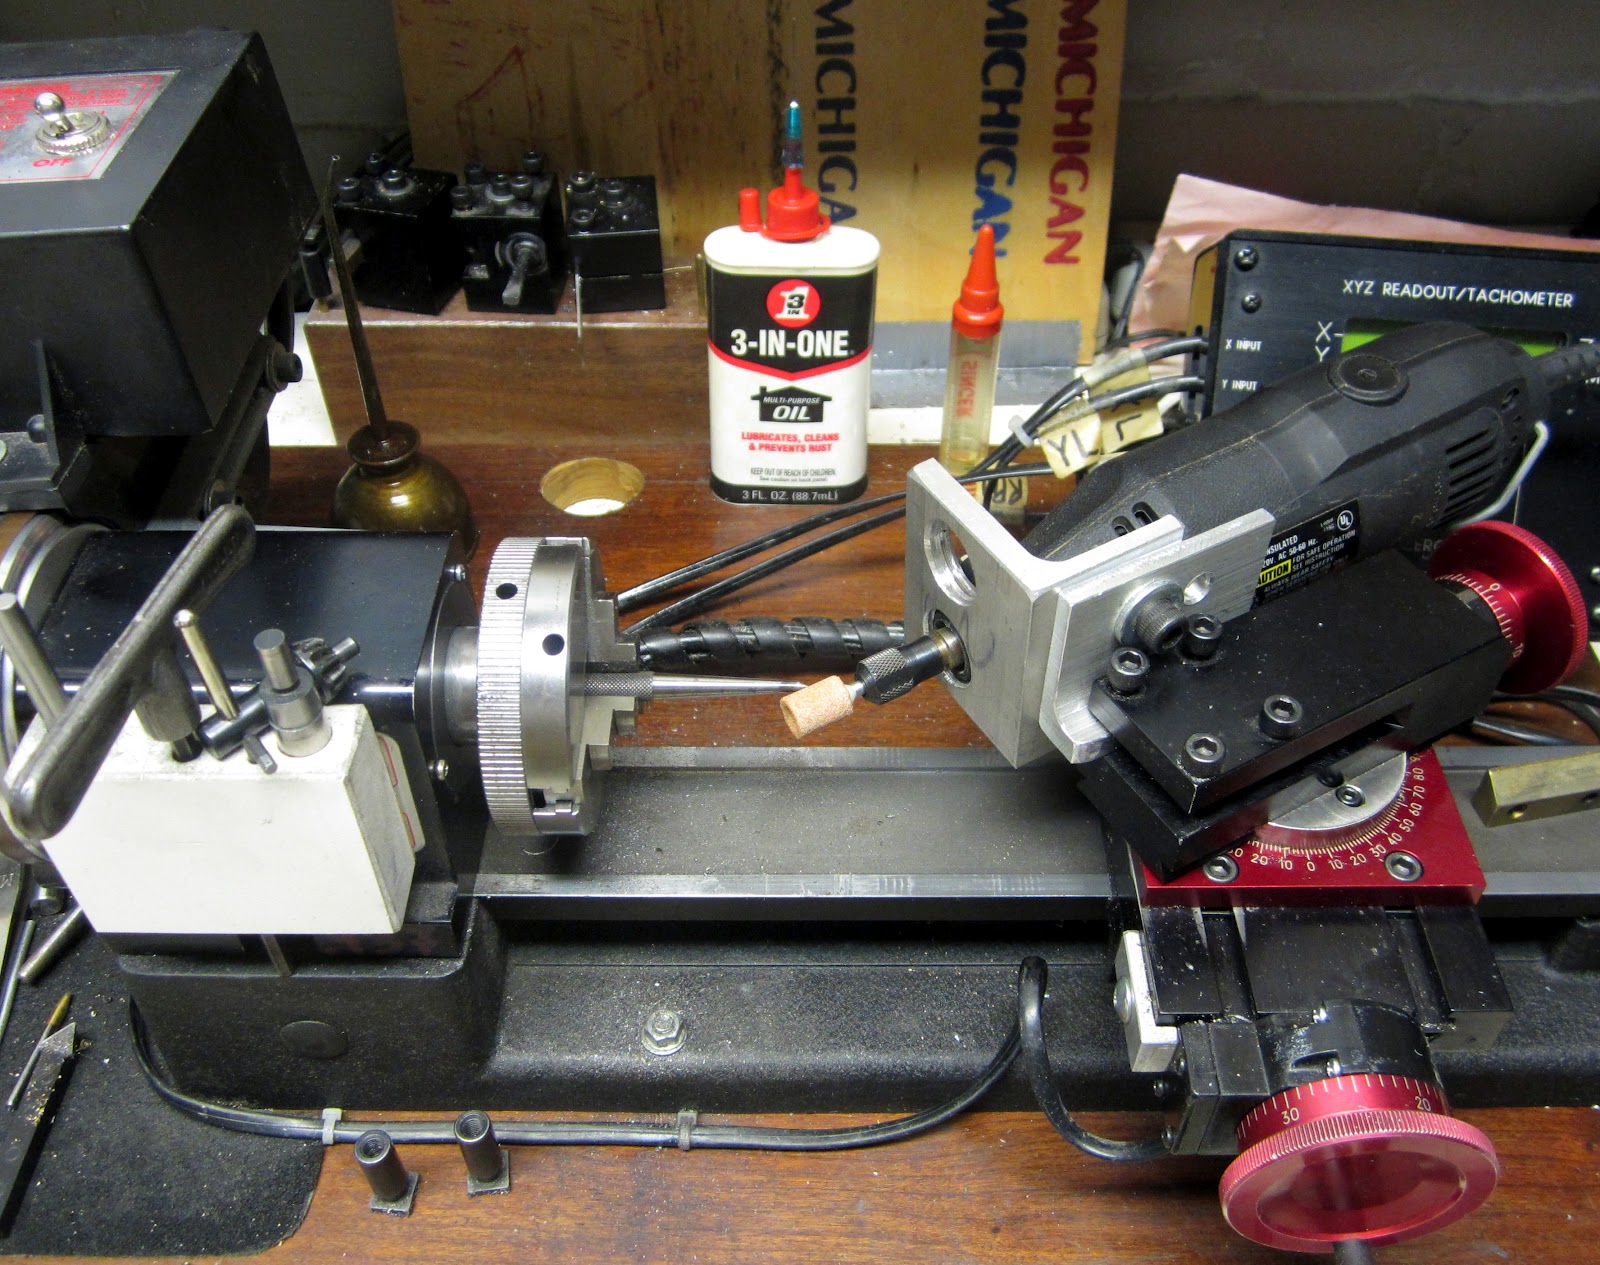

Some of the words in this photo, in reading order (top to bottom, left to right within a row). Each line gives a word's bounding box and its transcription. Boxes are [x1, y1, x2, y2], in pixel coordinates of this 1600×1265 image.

[814, 0, 857, 226] MICHIGA
[1043, 0, 1099, 264] MICHIGAN
[32, 157, 73, 167] OFF
[1342, 279, 1374, 295] XYZ
[1382, 280, 1574, 308] READOUT/TACHOMETER
[1315, 320, 1333, 343] X
[730, 328, 849, 357] 3-IN-ONE
[1225, 338, 1232, 350] X
[1236, 340, 1262, 351] INPUT
[1315, 345, 1331, 363] Y
[1221, 378, 1228, 389] Y
[1231, 379, 1258, 391] INPUT
[762, 396, 820, 404] MULTI-PURPOSE
[772, 405, 811, 421] OIL
[741, 431, 801, 443] LUBRICATES,
[804, 433, 839, 443] CLEANS
[748, 442, 756, 451] &
[758, 443, 806, 453] PREVENTS
[808, 443, 833, 452] RUST
[750, 467, 763, 475] KEEP
[764, 468, 775, 476] OUT
[776, 468, 783, 476] OF
[784, 468, 801, 477] REACH
[802, 469, 809, 477] OF
[742, 489, 749, 500] 3
[751, 490, 767, 500] FL.
[770, 490, 789, 500] OZ.
[791, 490, 839, 501] (88.7mL)
[1266, 534, 1298, 555] NSULATED
[1278, 550, 1287, 560] AC
[1489, 582, 1501, 591] 0
[1412, 767, 1425, 781] 80
[1412, 785, 1425, 799] 70
[1408, 802, 1423, 817] 60
[1398, 818, 1415, 833] 50
[1387, 832, 1403, 846] 40
[1368, 844, 1387, 858] 30
[1250, 853, 1269, 866] 20
[1279, 856, 1293, 870] 10
[1328, 858, 1344, 870] 10
[1349, 852, 1367, 866] 20
[1306, 861, 1316, 872] 0
[1281, 1107, 1300, 1125] 30
[1414, 1095, 1432, 1112] 20
